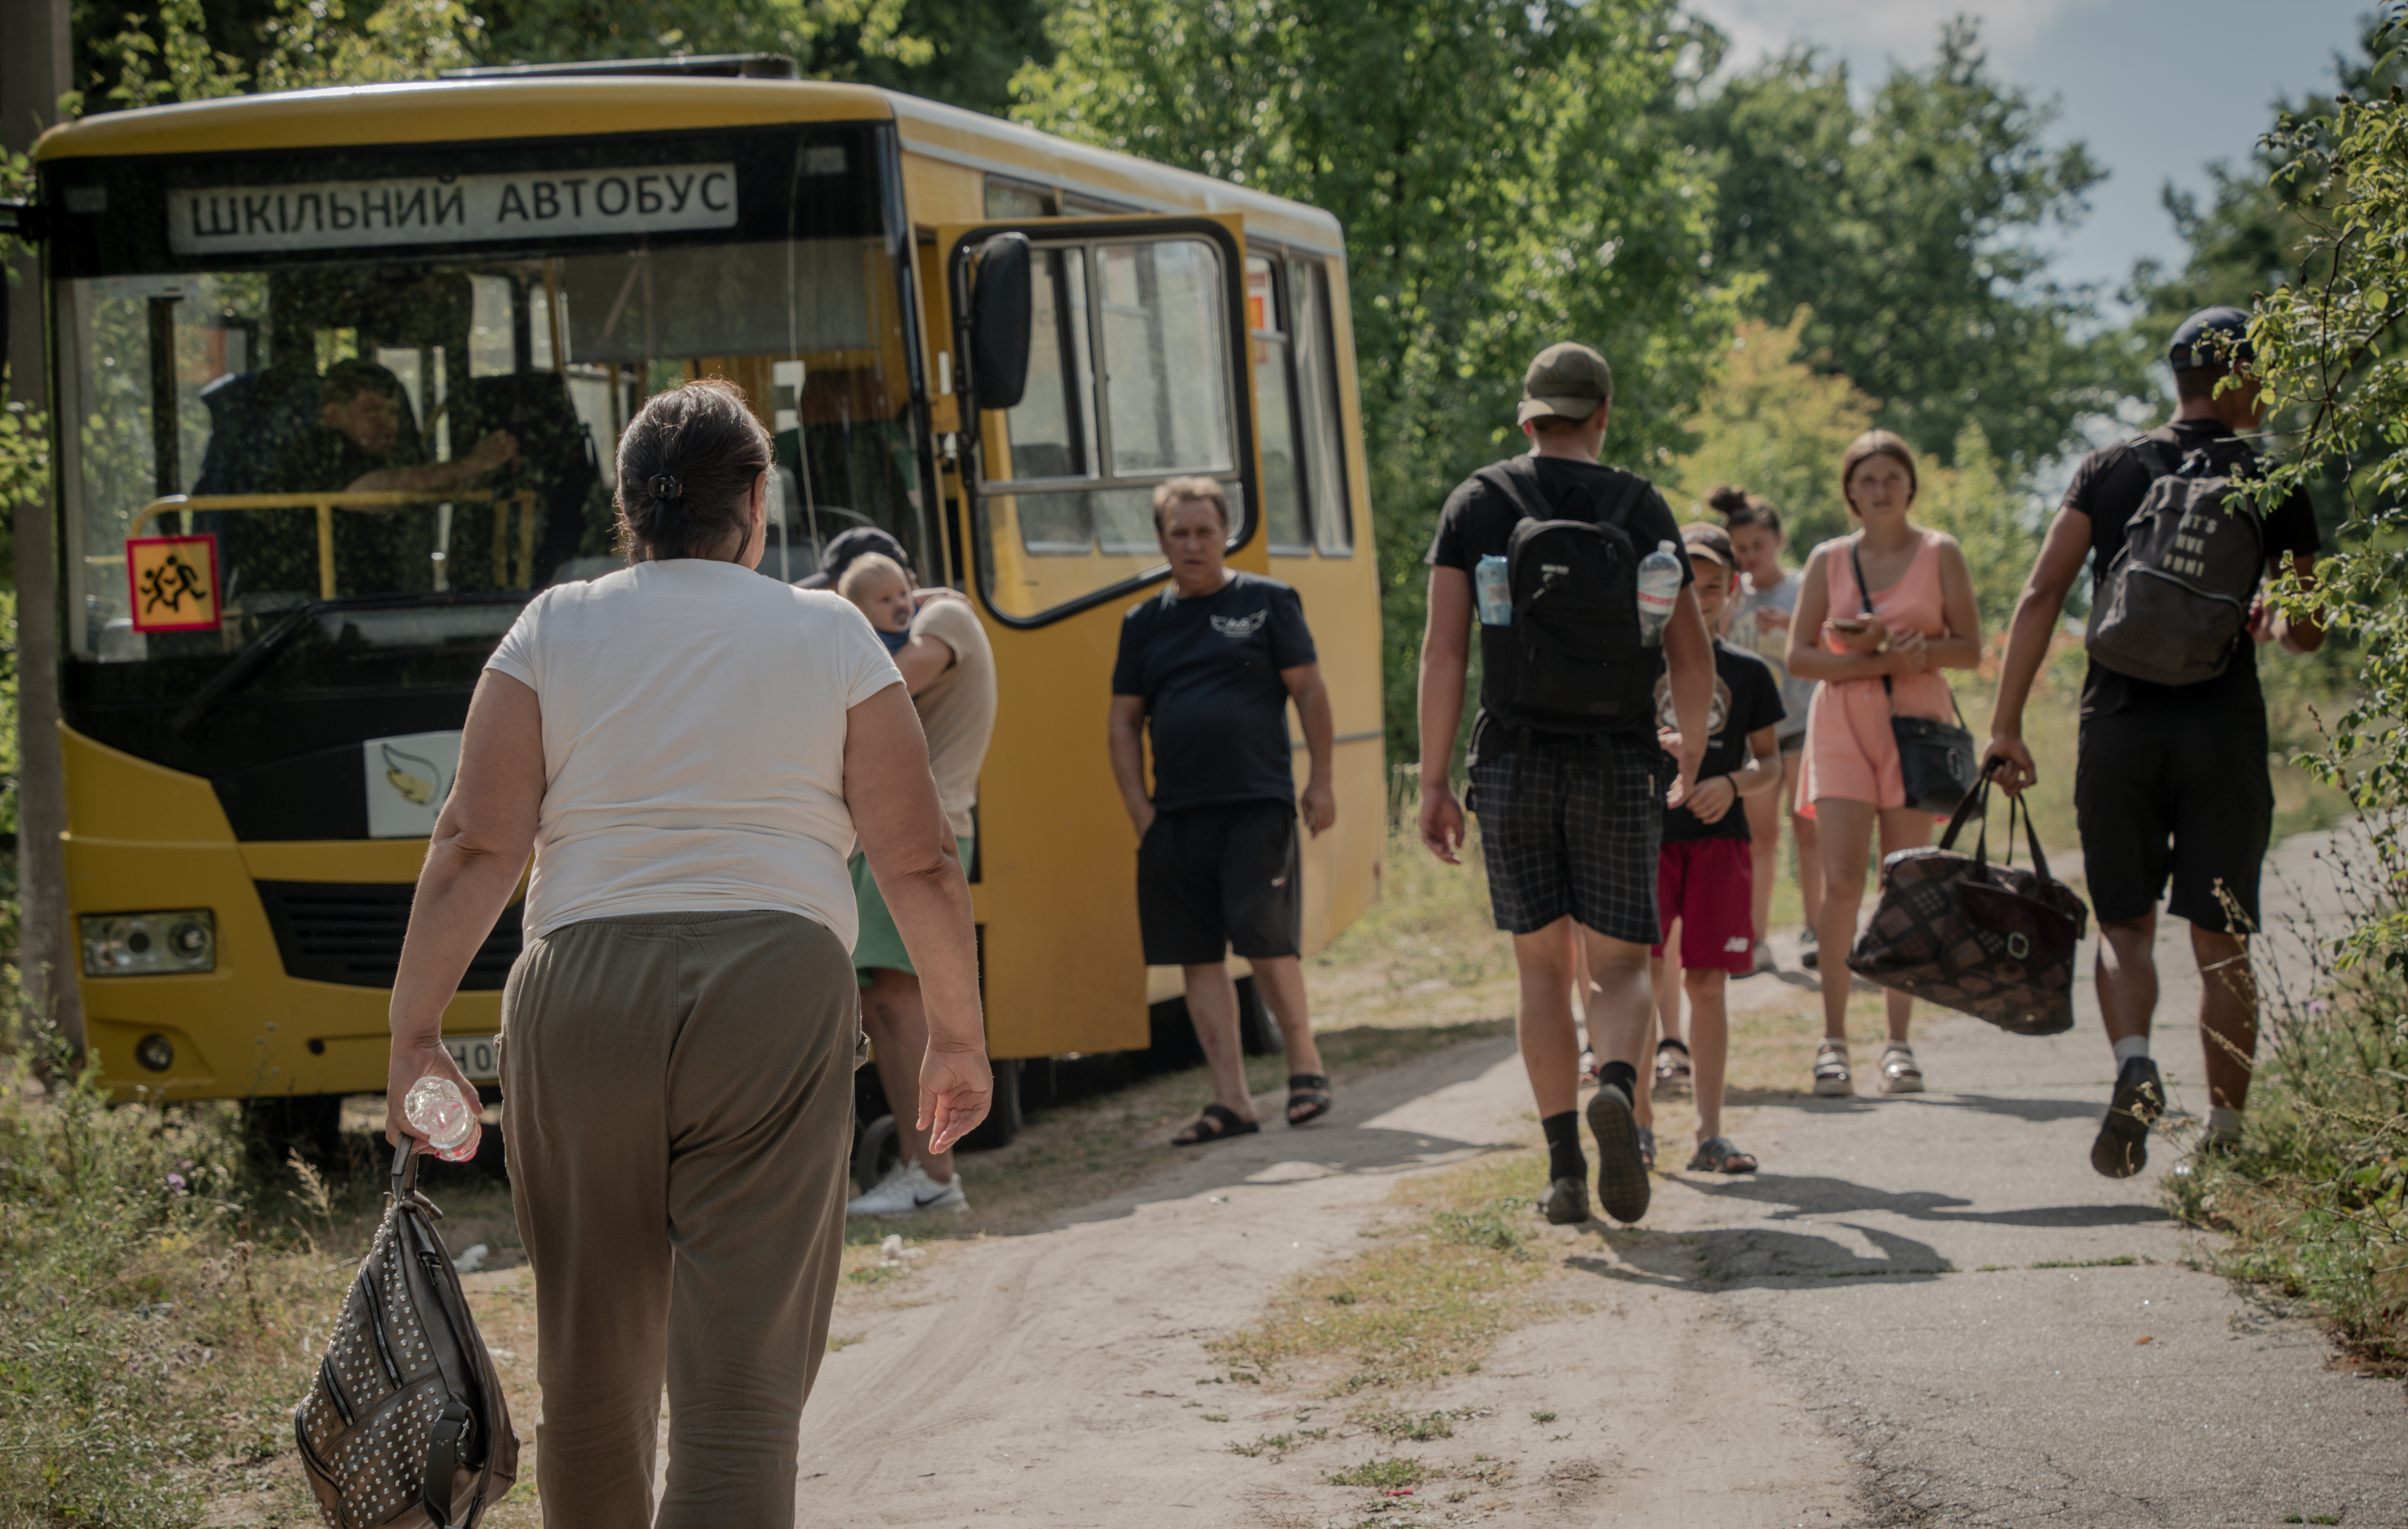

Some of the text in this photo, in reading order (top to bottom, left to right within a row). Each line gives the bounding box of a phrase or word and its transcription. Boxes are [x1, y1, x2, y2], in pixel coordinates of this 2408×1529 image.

[190, 172, 729, 237] ШКІЛЬНИЙ АВТОБУС
[2163, 553, 2205, 578] FUN!
